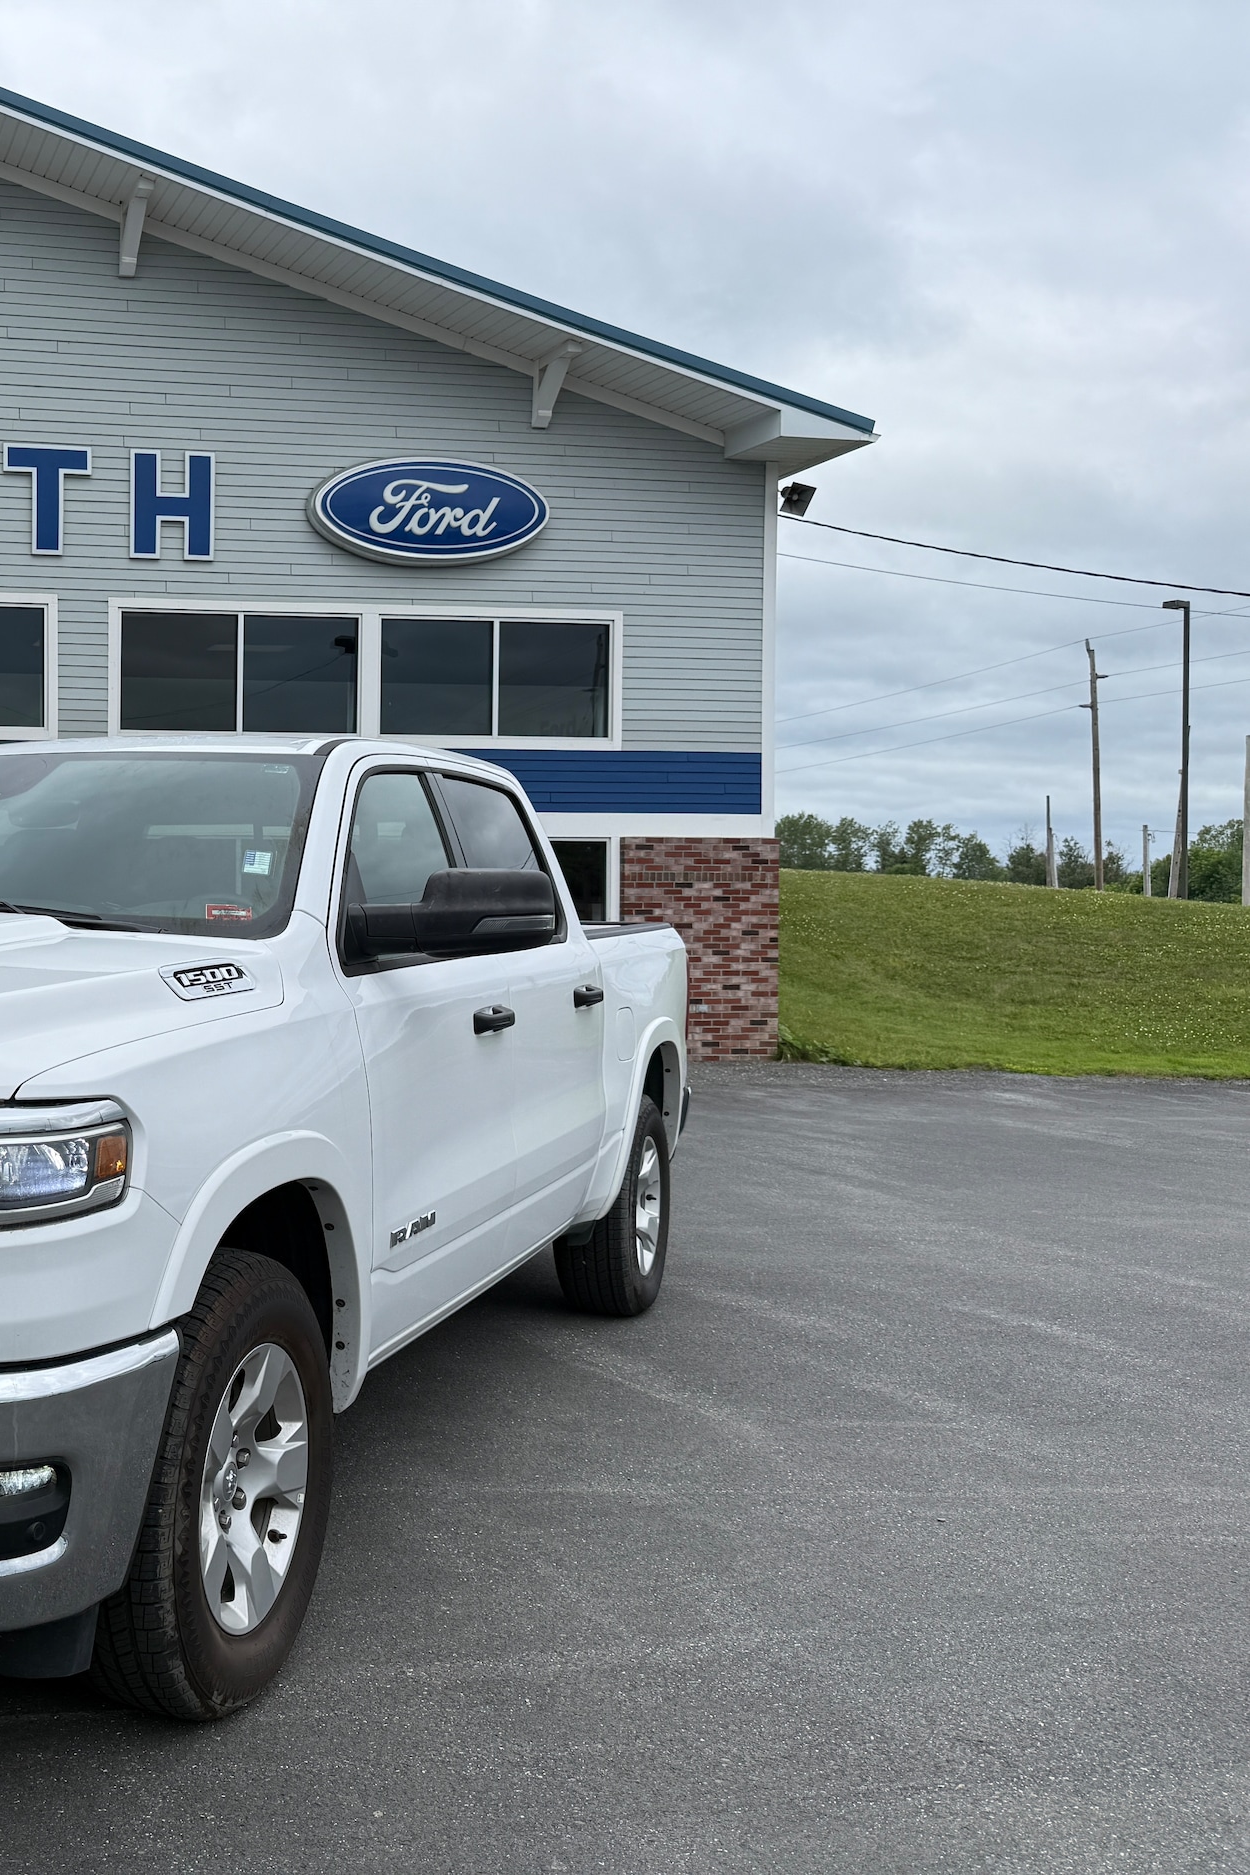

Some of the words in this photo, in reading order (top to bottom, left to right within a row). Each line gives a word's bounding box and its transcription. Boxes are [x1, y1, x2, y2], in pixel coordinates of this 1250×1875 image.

[368, 479, 501, 537] Ford
[175, 966, 239, 987] 1500
[203, 981, 233, 993] SST
[390, 1209, 436, 1249] RAM
